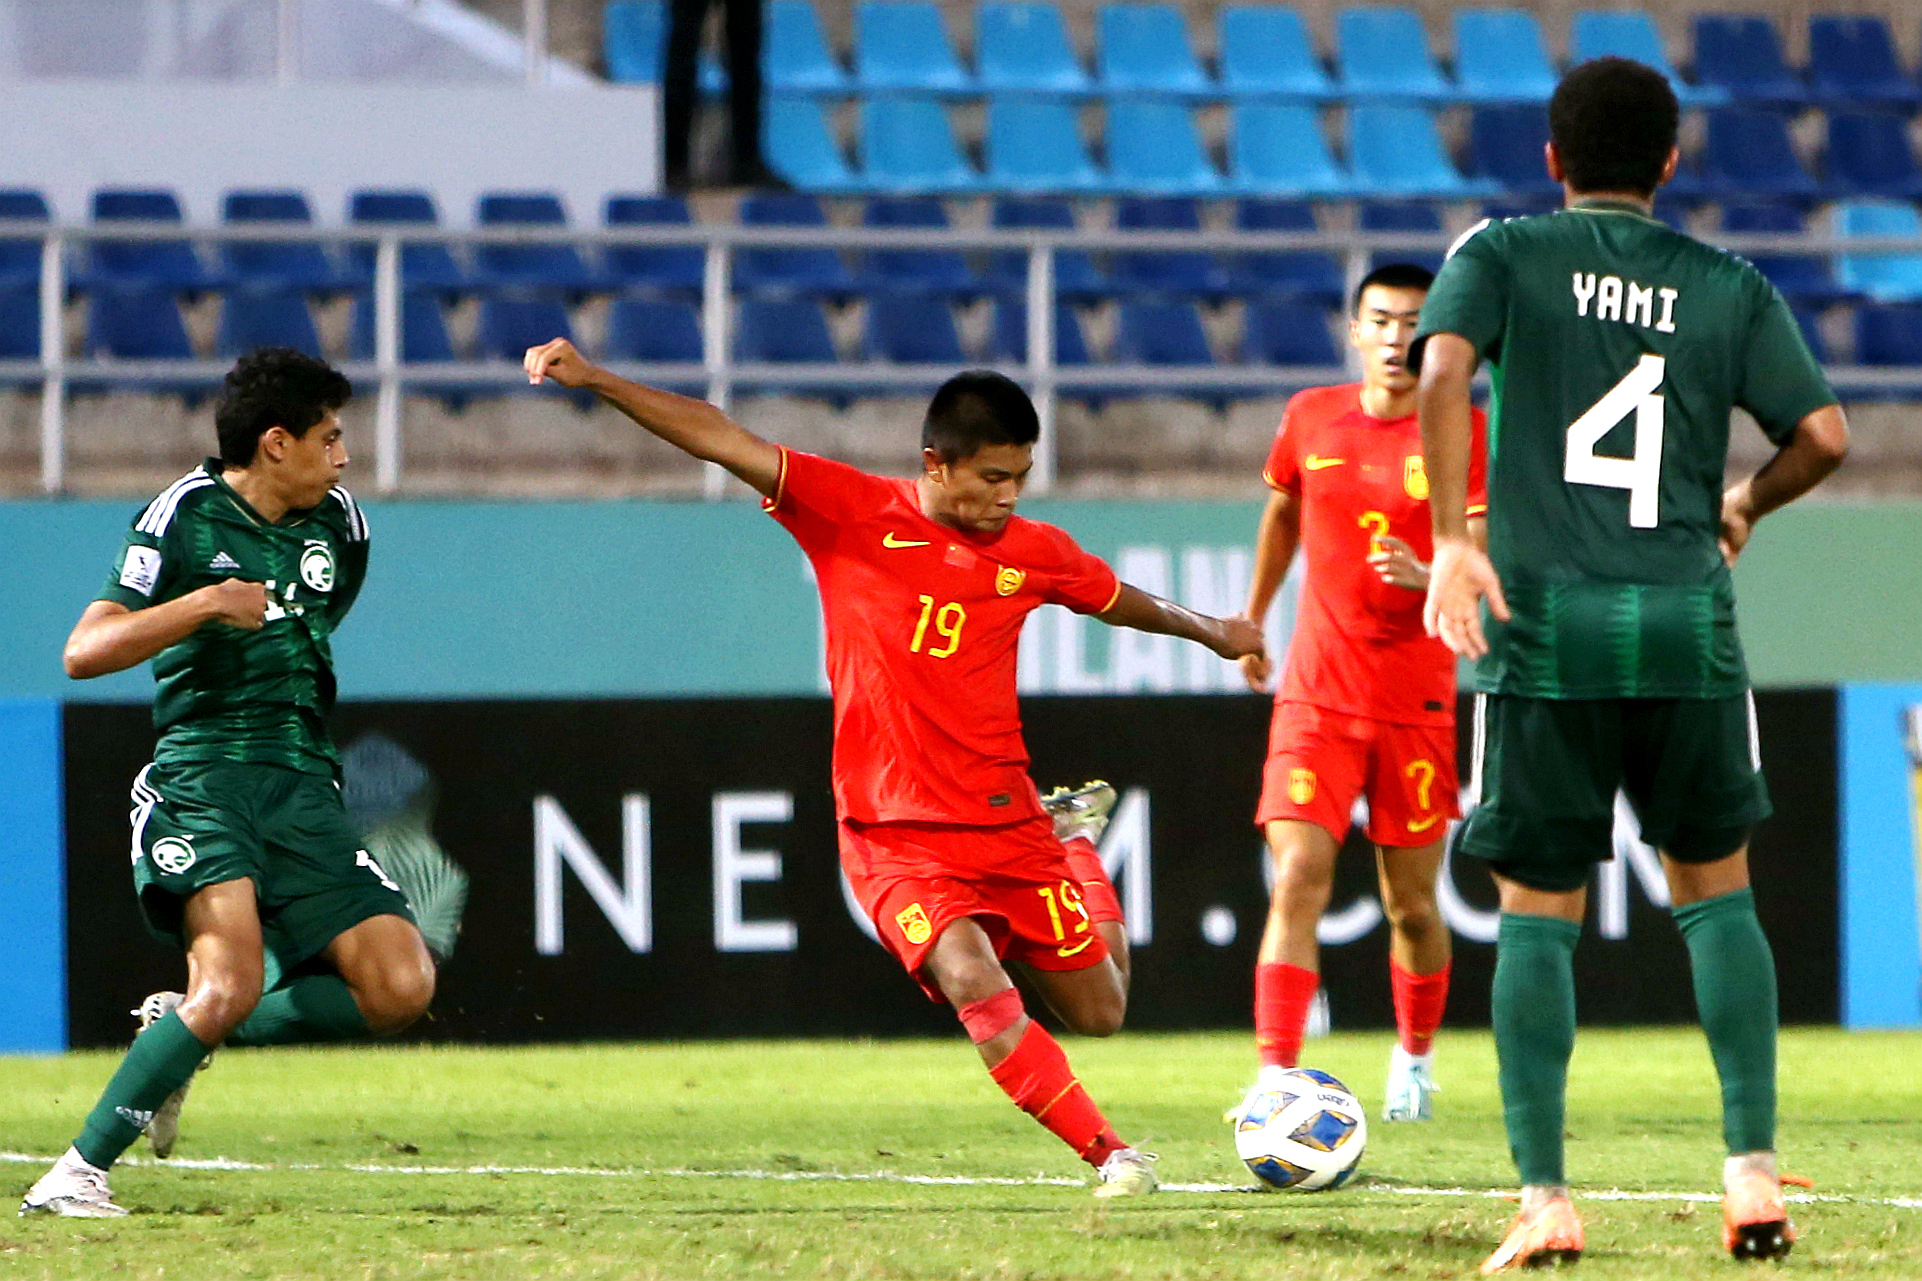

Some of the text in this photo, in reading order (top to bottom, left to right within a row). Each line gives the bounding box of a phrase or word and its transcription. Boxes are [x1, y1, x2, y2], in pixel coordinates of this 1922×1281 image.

[1572, 271, 1679, 333] YAMI
[1563, 353, 1666, 528] 4
[910, 594, 967, 658] 19
[1405, 759, 1435, 810] 7
[1038, 880, 1090, 941] 19
